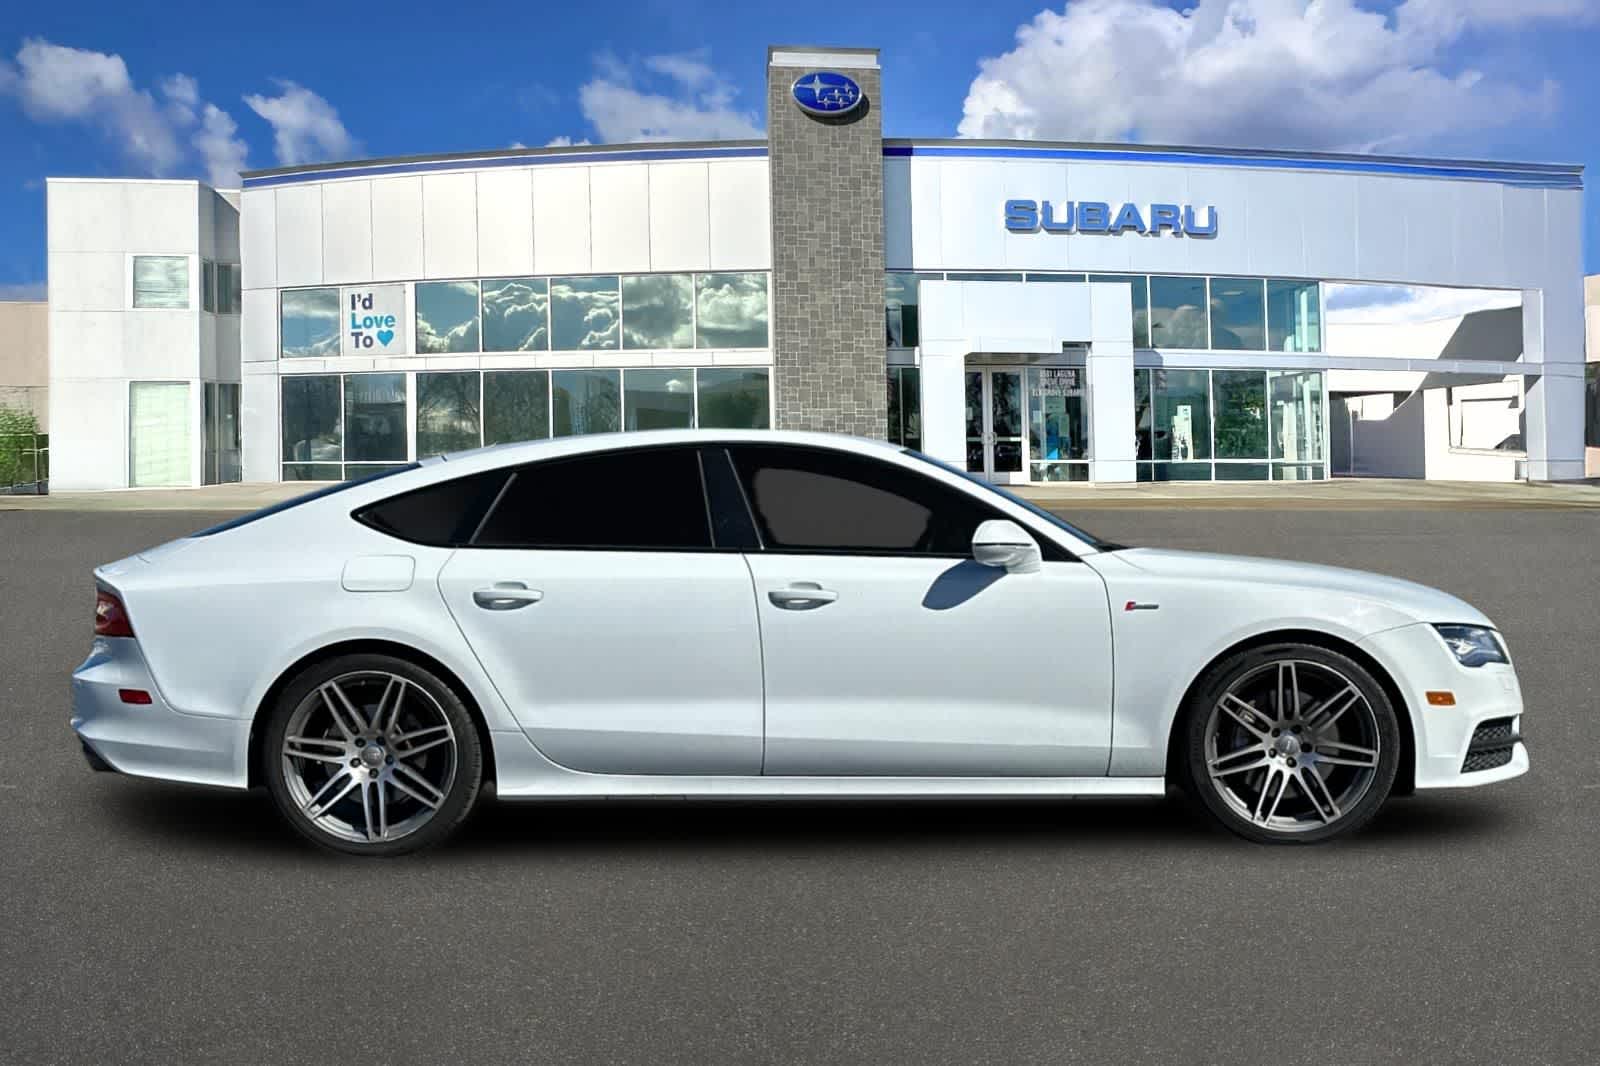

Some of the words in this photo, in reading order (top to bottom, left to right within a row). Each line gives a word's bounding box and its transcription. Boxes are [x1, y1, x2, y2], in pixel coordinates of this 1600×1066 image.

[1005, 199, 1217, 236] SUBARU
[351, 293, 373, 310] I’d
[351, 312, 396, 329] Love
[351, 331, 374, 348] To
